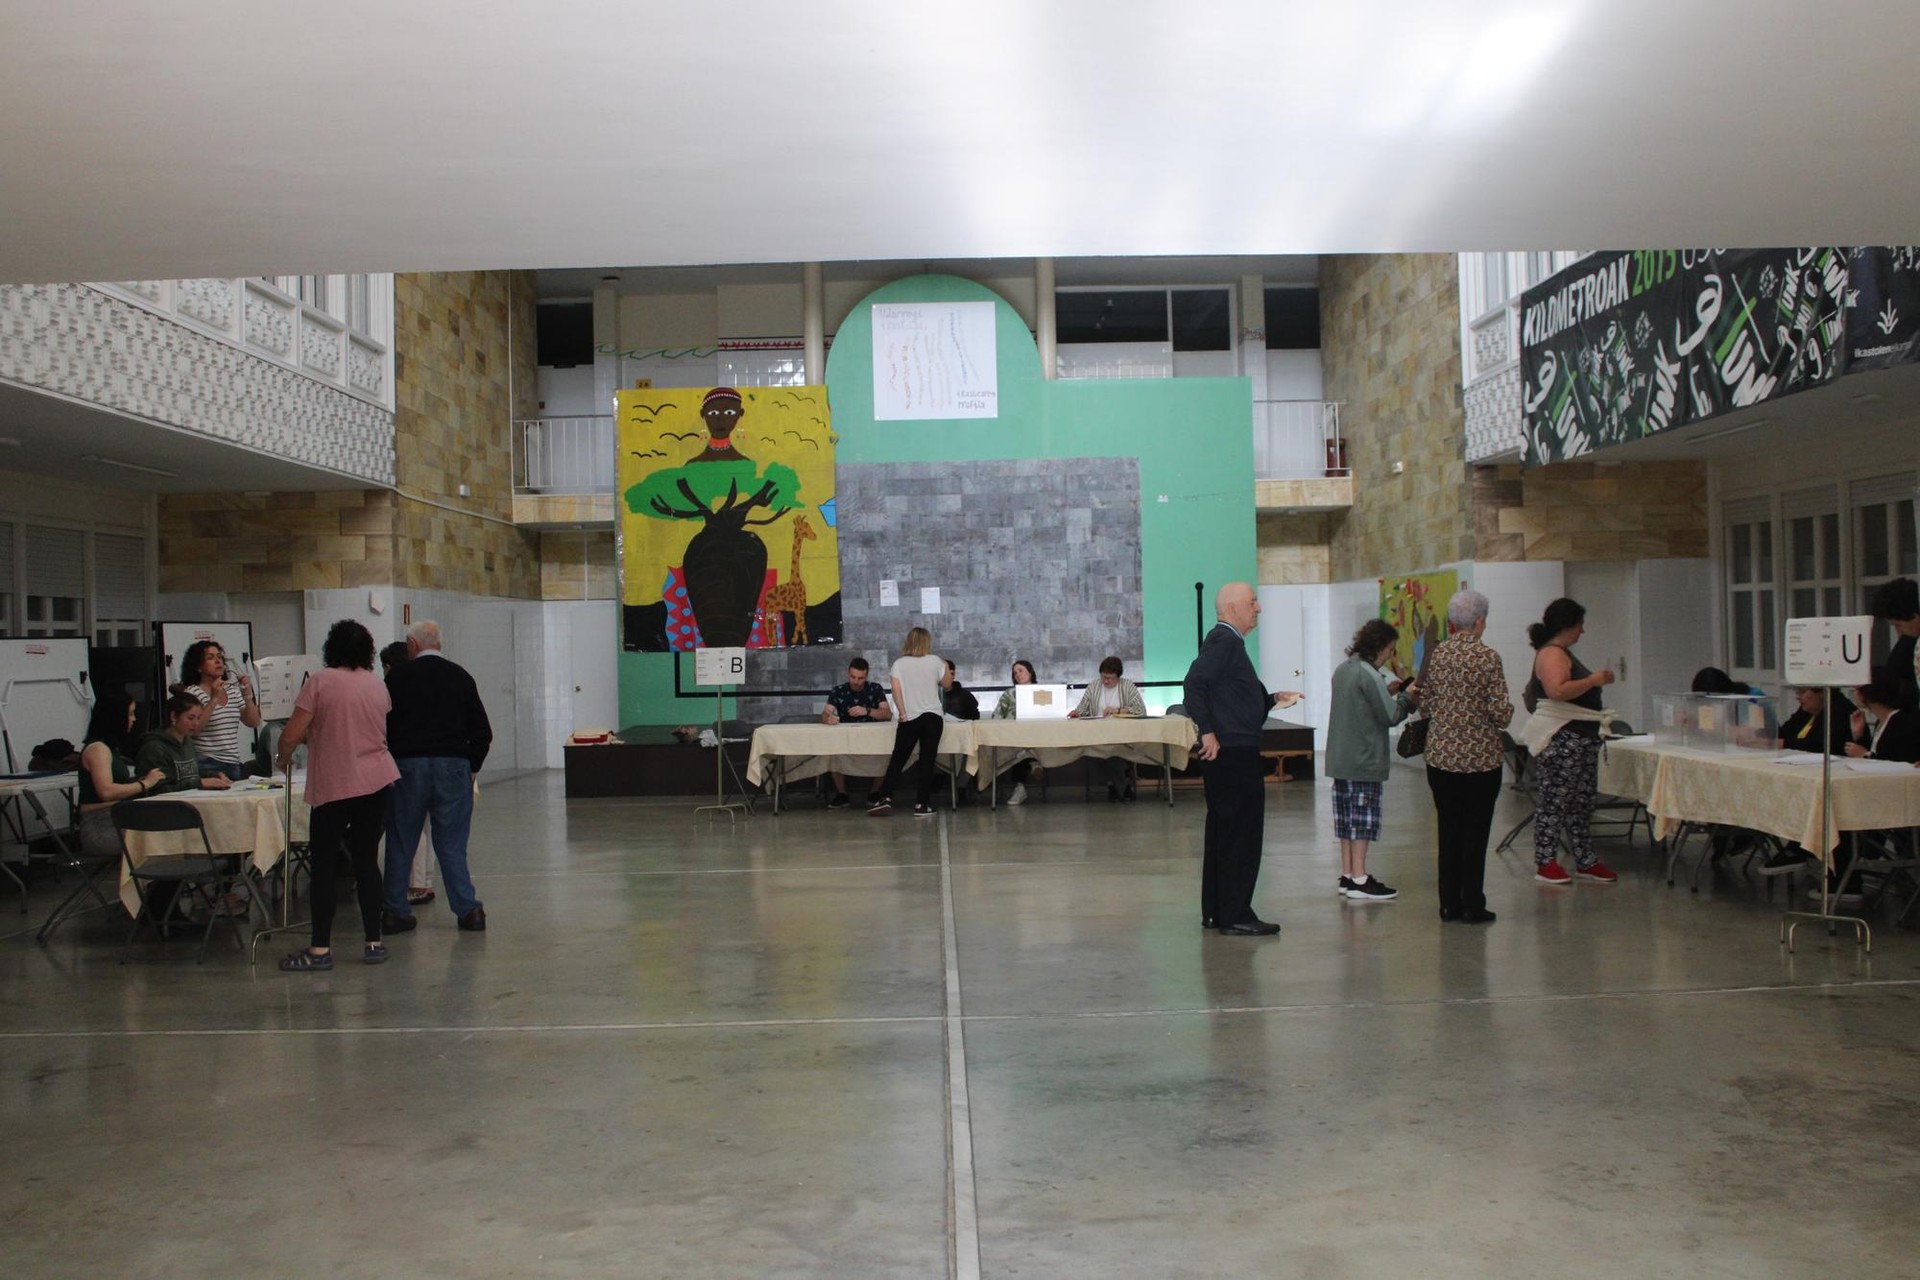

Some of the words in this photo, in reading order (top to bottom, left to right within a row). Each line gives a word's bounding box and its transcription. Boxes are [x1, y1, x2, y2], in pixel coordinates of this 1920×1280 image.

[1523, 253, 1630, 347] KILOMETROAK
[1842, 633, 1862, 664] U
[731, 656, 743, 673] B
